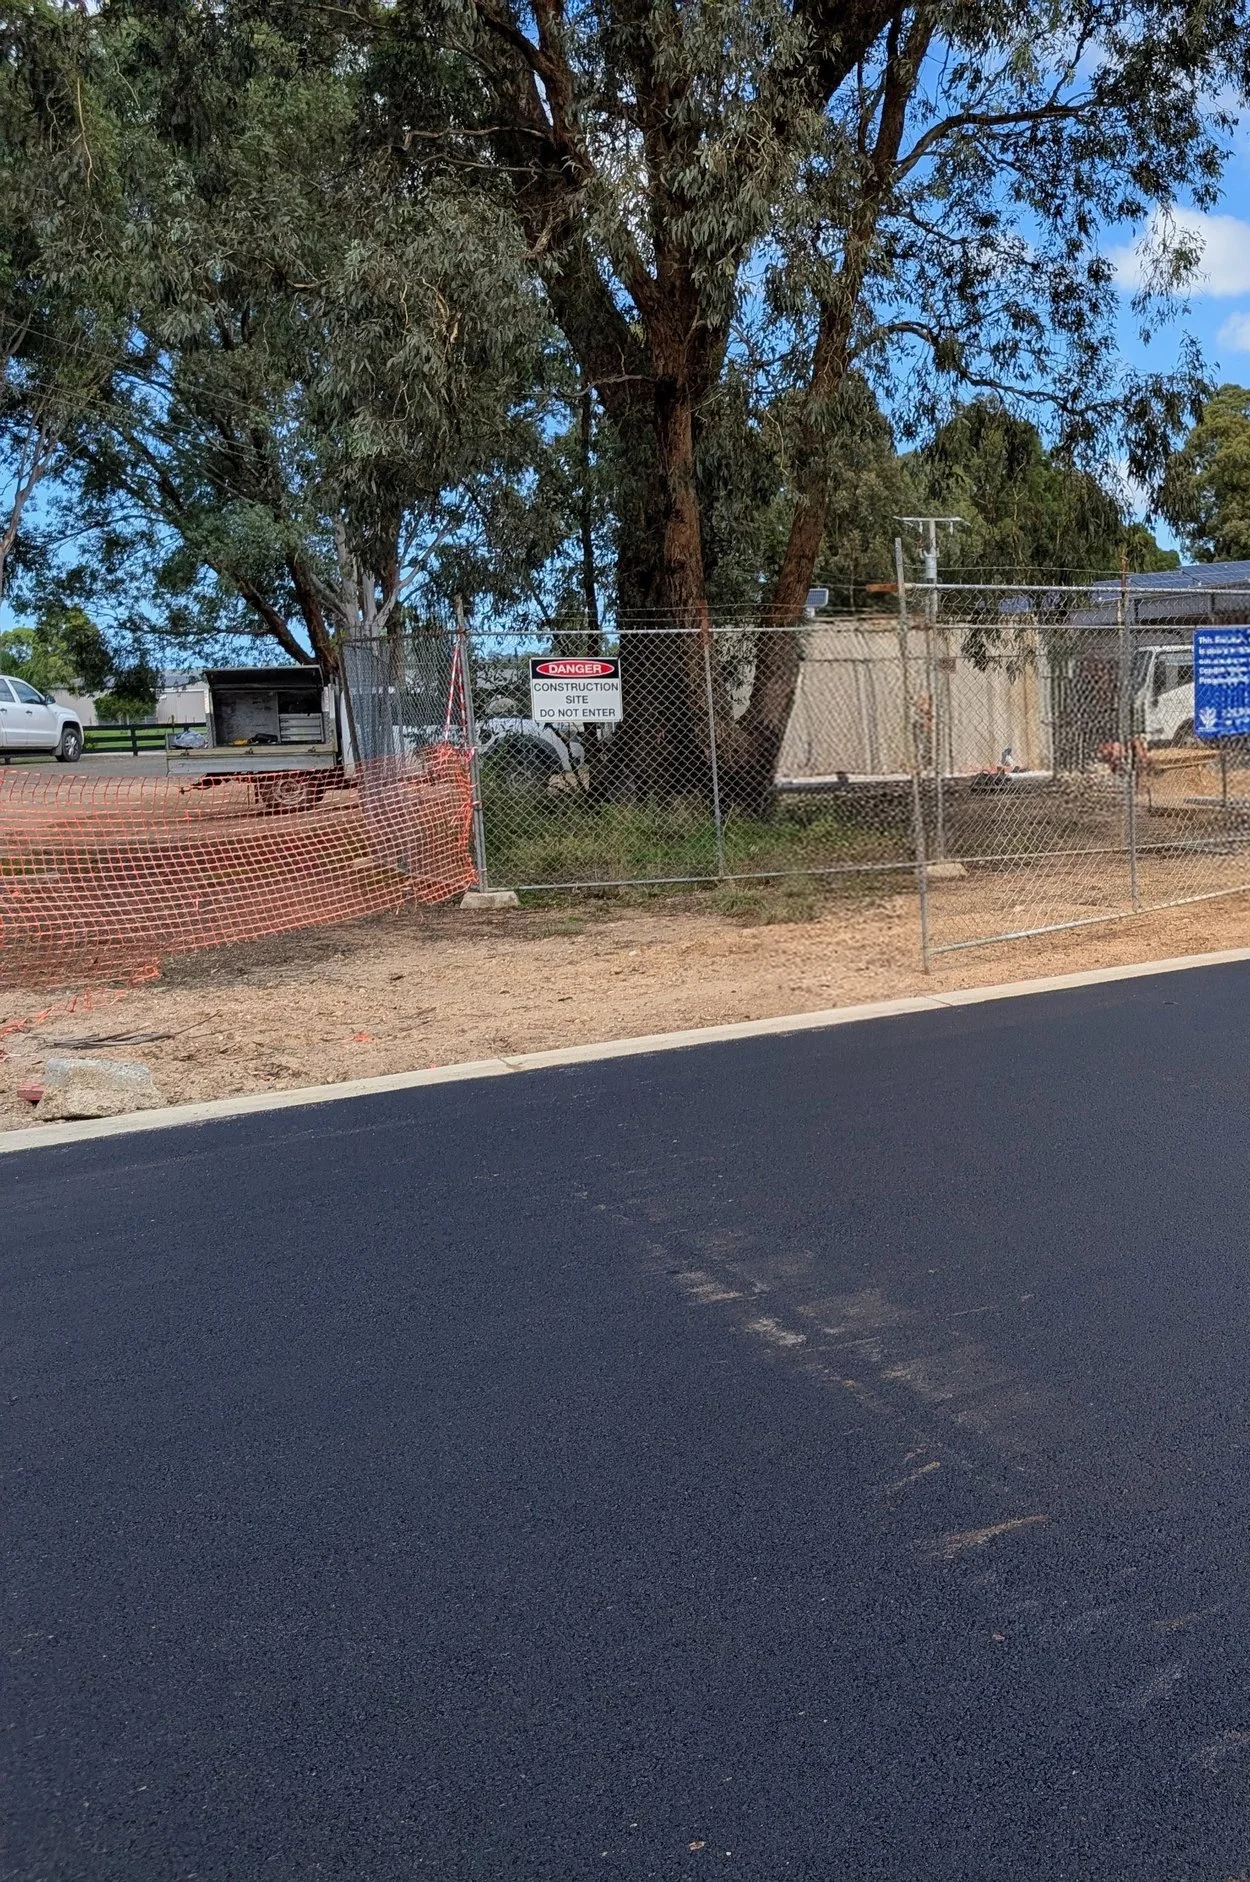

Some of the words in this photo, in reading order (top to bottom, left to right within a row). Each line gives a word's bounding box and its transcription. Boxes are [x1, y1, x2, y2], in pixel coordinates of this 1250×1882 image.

[549, 664, 602, 674] DANGER
[534, 682, 618, 691] CONSTRUCTION
[566, 695, 588, 704] SITE
[540, 709, 555, 717] DO
[559, 709, 579, 717] NOT
[583, 708, 615, 717] ENTER
